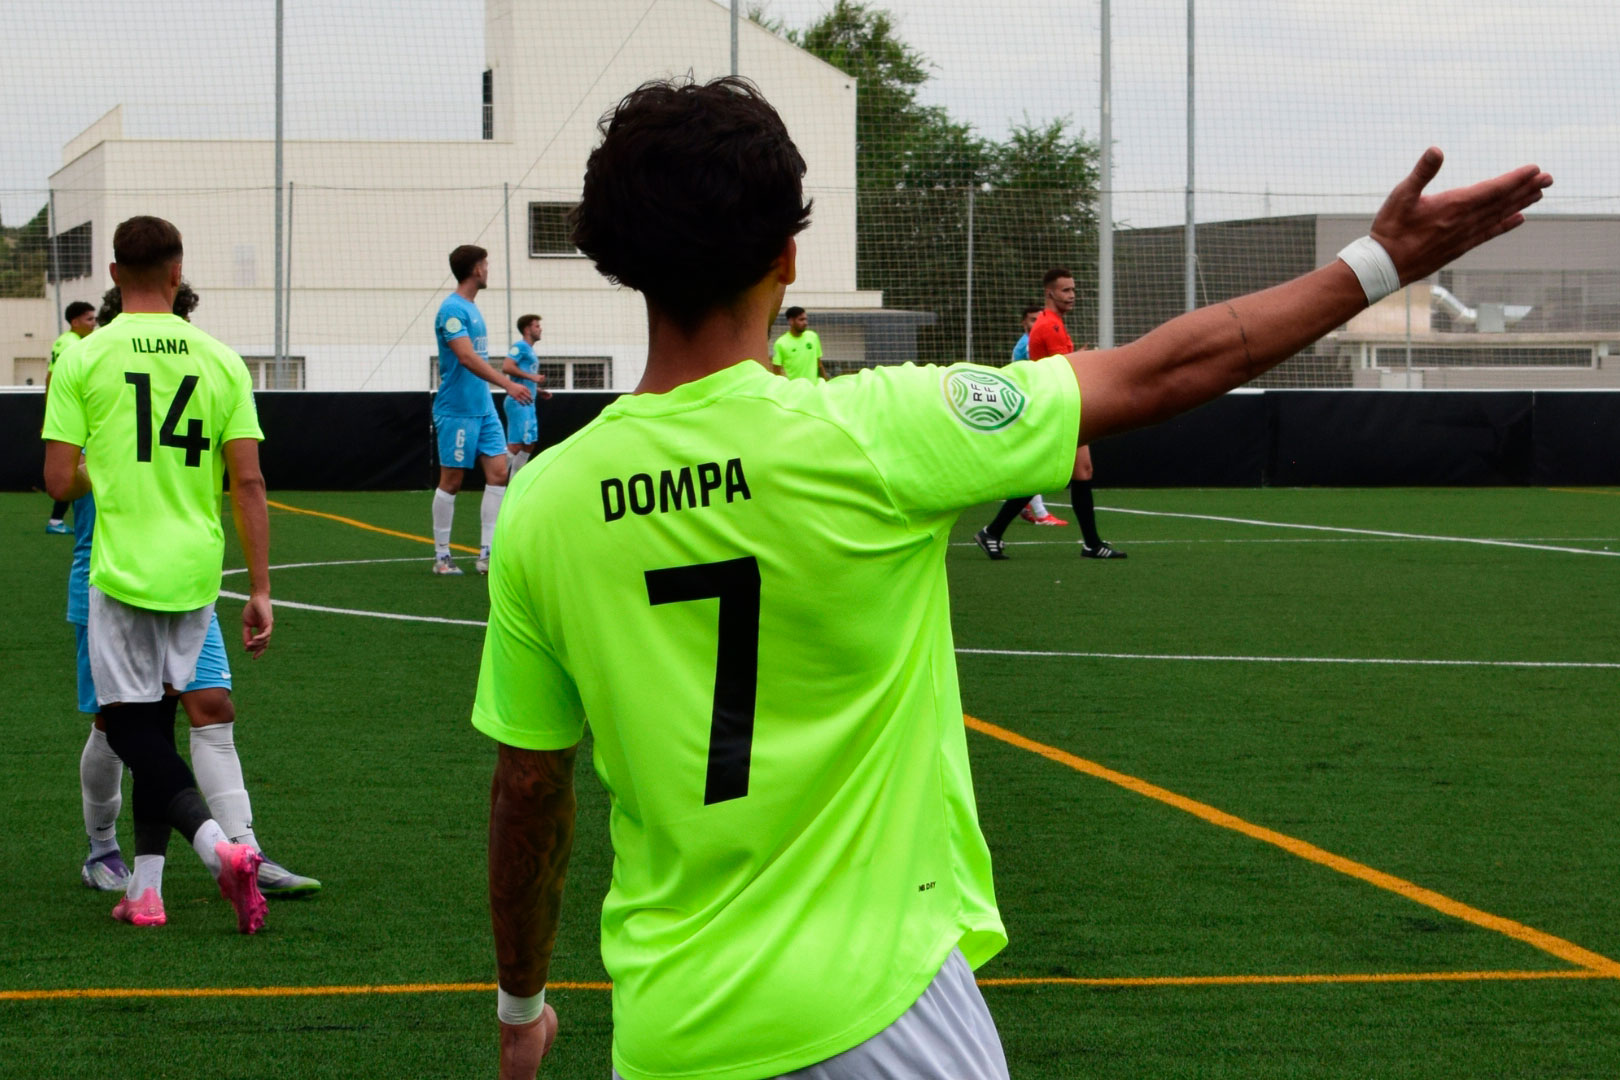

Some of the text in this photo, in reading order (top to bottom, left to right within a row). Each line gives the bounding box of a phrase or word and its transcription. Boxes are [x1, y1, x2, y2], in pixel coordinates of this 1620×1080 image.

[132, 338, 189, 355] ILLANA
[124, 372, 211, 467] 14
[601, 458, 752, 522] DOMPA
[644, 556, 761, 806] 7
